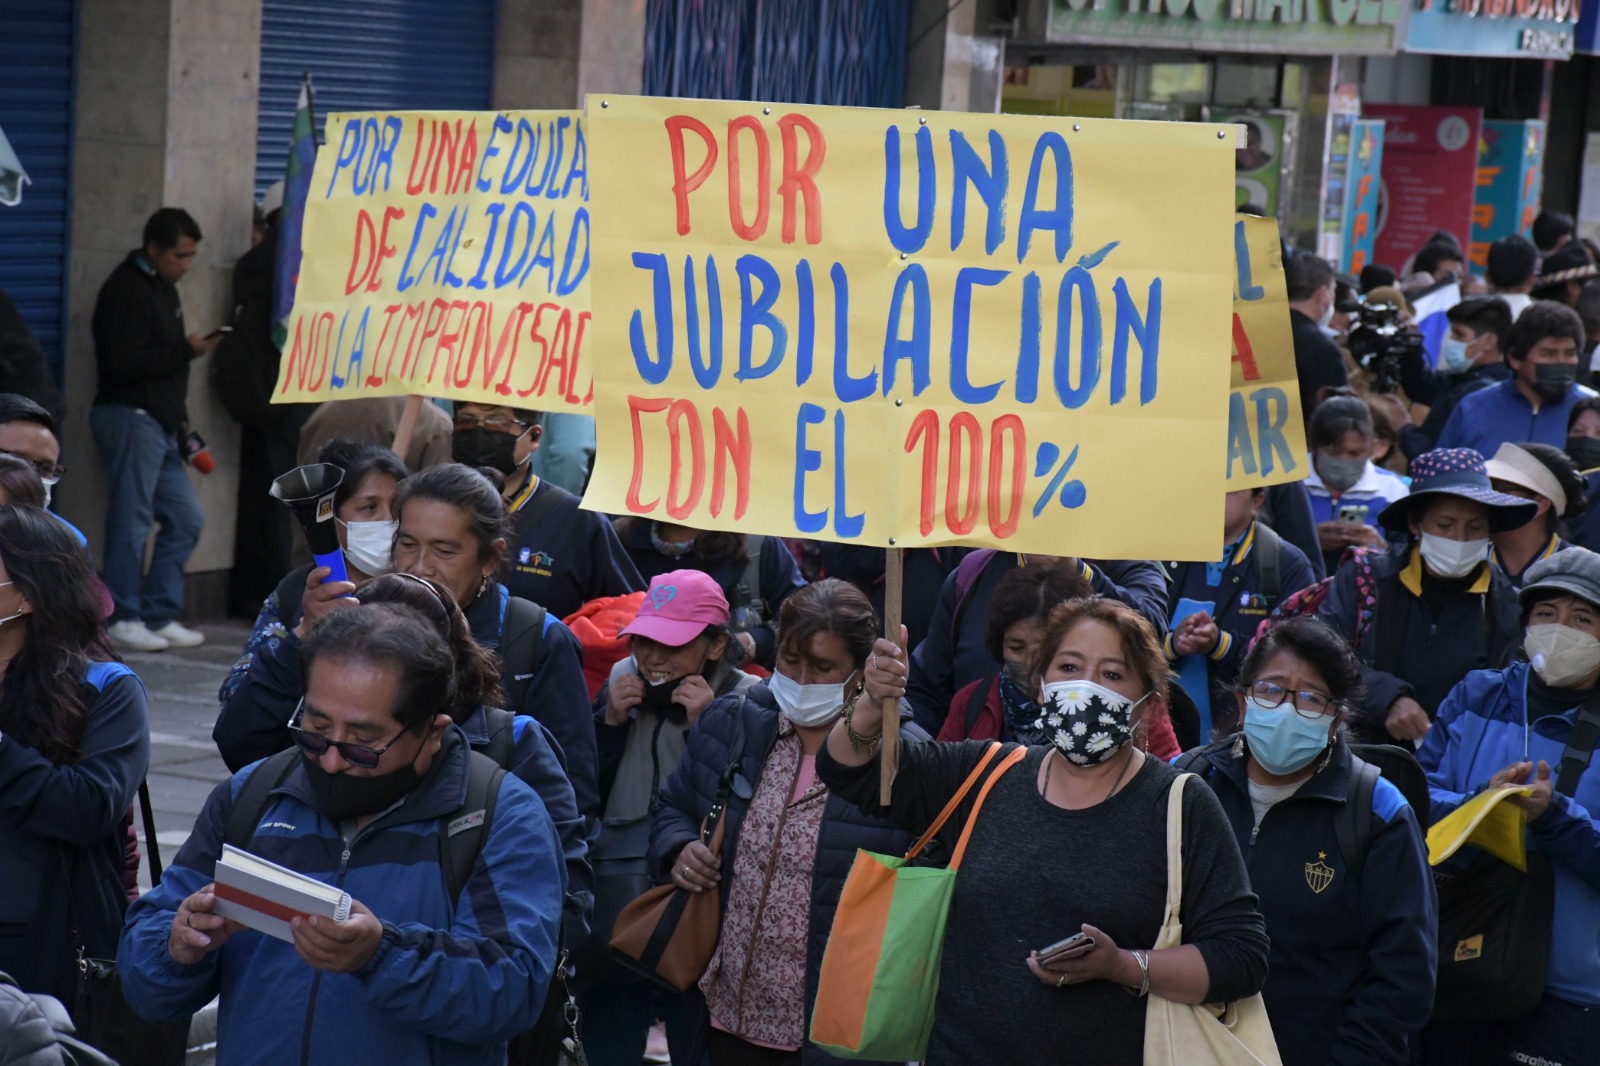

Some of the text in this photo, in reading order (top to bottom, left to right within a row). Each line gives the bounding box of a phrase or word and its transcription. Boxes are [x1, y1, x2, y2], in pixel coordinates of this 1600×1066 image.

[326, 113, 589, 201] POR UNA EDUCA
[664, 113, 1074, 264] POR UNA
[344, 201, 590, 297] DE CALIDAD
[282, 297, 594, 406] NO LA IMPROVISAC
[629, 240, 1163, 409] JUBILACIÓN
[625, 394, 1087, 539] CON EL 100%
